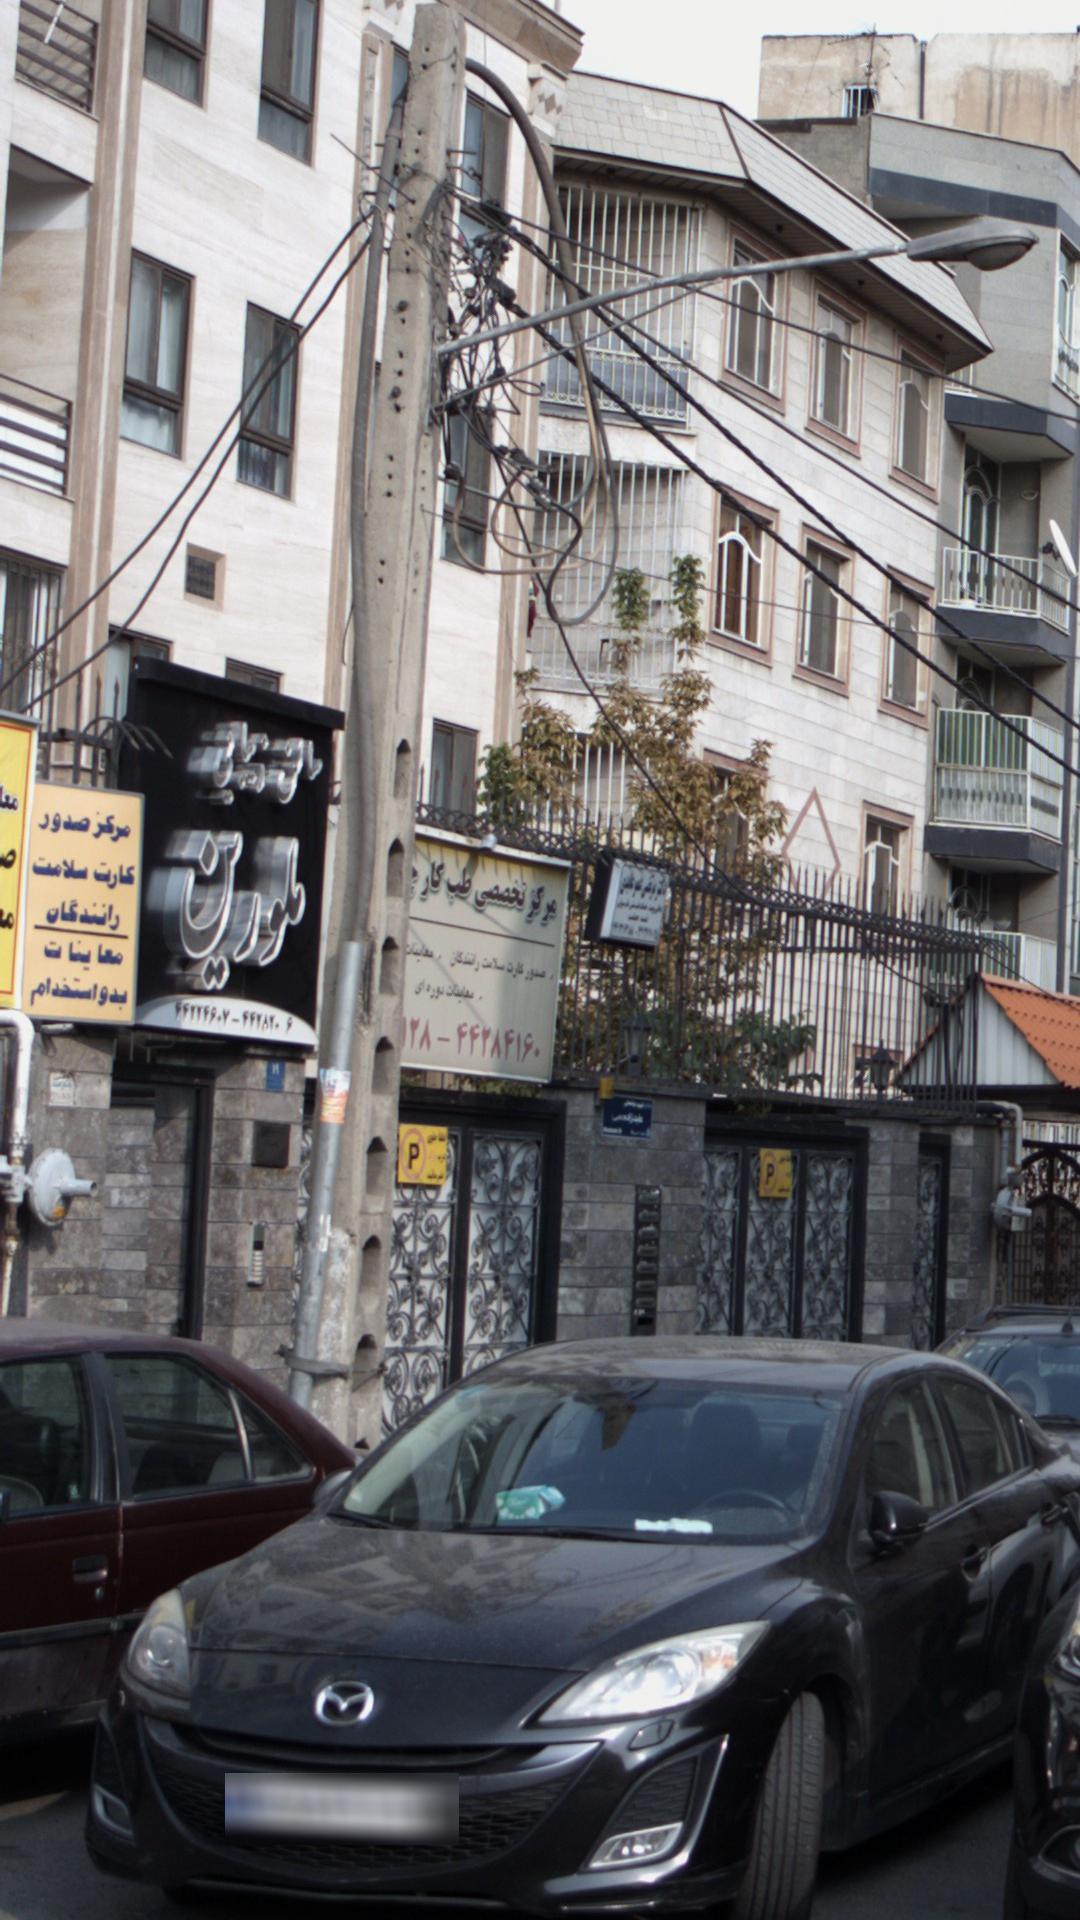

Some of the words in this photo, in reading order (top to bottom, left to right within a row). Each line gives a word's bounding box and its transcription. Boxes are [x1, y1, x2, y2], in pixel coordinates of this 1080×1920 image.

[38, 811, 91, 833] صدور
[93, 811, 131, 842] مرکز
[32, 856, 88, 880] سلامت
[93, 861, 135, 889] کارت
[420, 860, 444, 898] کار
[446, 866, 472, 904] طب
[474, 878, 526, 910] تخصصی
[46, 899, 120, 930] رانندگان
[525, 884, 558, 923] مرکز
[407, 1142, 420, 1169] P
[766, 1162, 775, 1186] P
